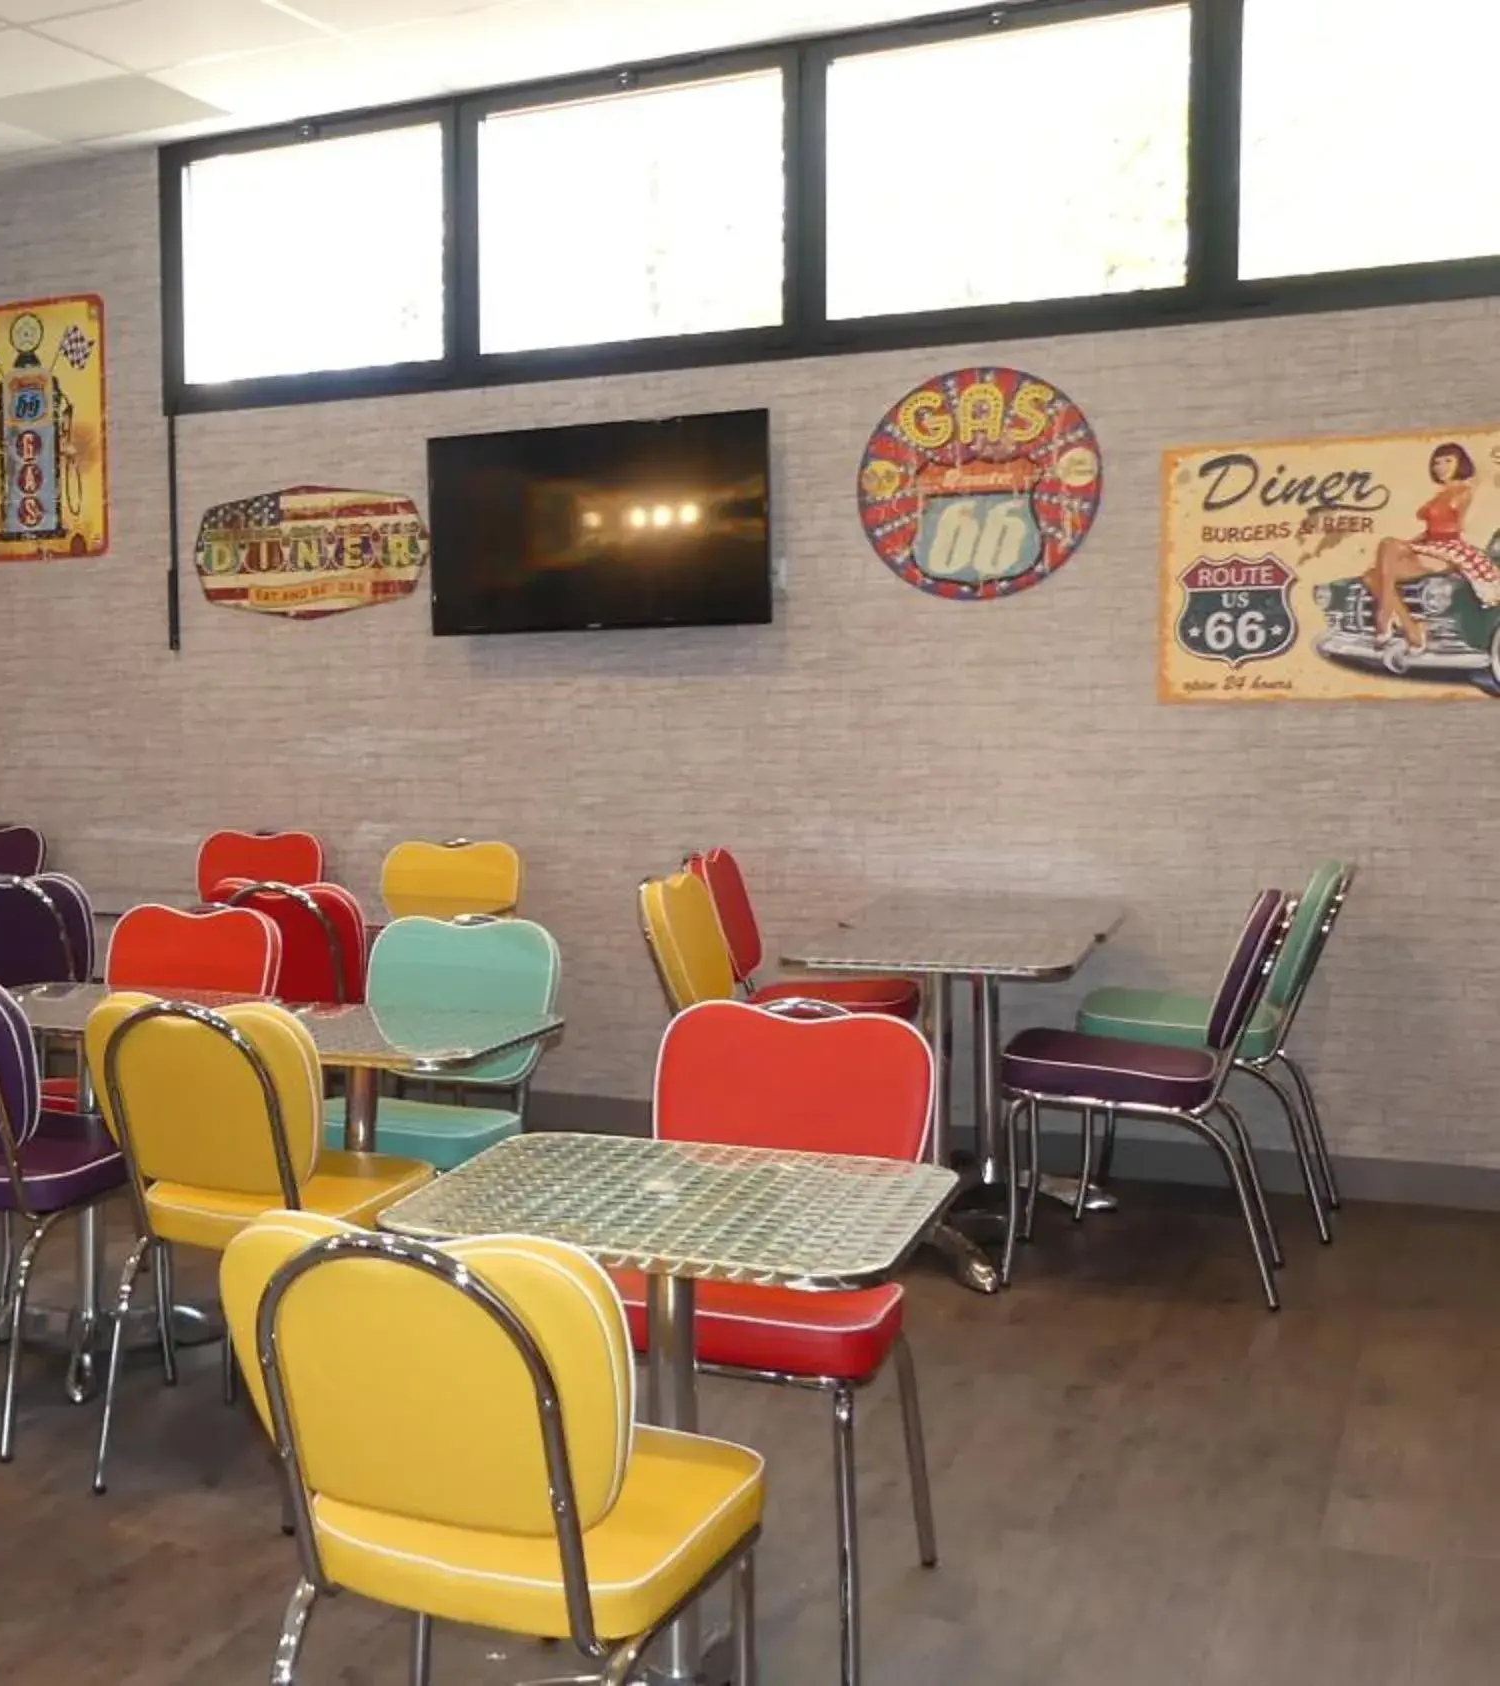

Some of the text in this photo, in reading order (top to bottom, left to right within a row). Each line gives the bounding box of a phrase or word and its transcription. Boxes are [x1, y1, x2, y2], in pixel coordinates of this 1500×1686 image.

[899, 383, 1054, 448] GAS
[1197, 453, 1391, 516] Diner
[928, 500, 1026, 576] 66
[1201, 522, 1292, 544] BURGERS
[1323, 514, 1375, 535] BEER
[210, 532, 416, 574] DINER
[1198, 565, 1275, 586] ROUTE
[1220, 592, 1251, 609] US
[1203, 610, 1267, 651] 66
